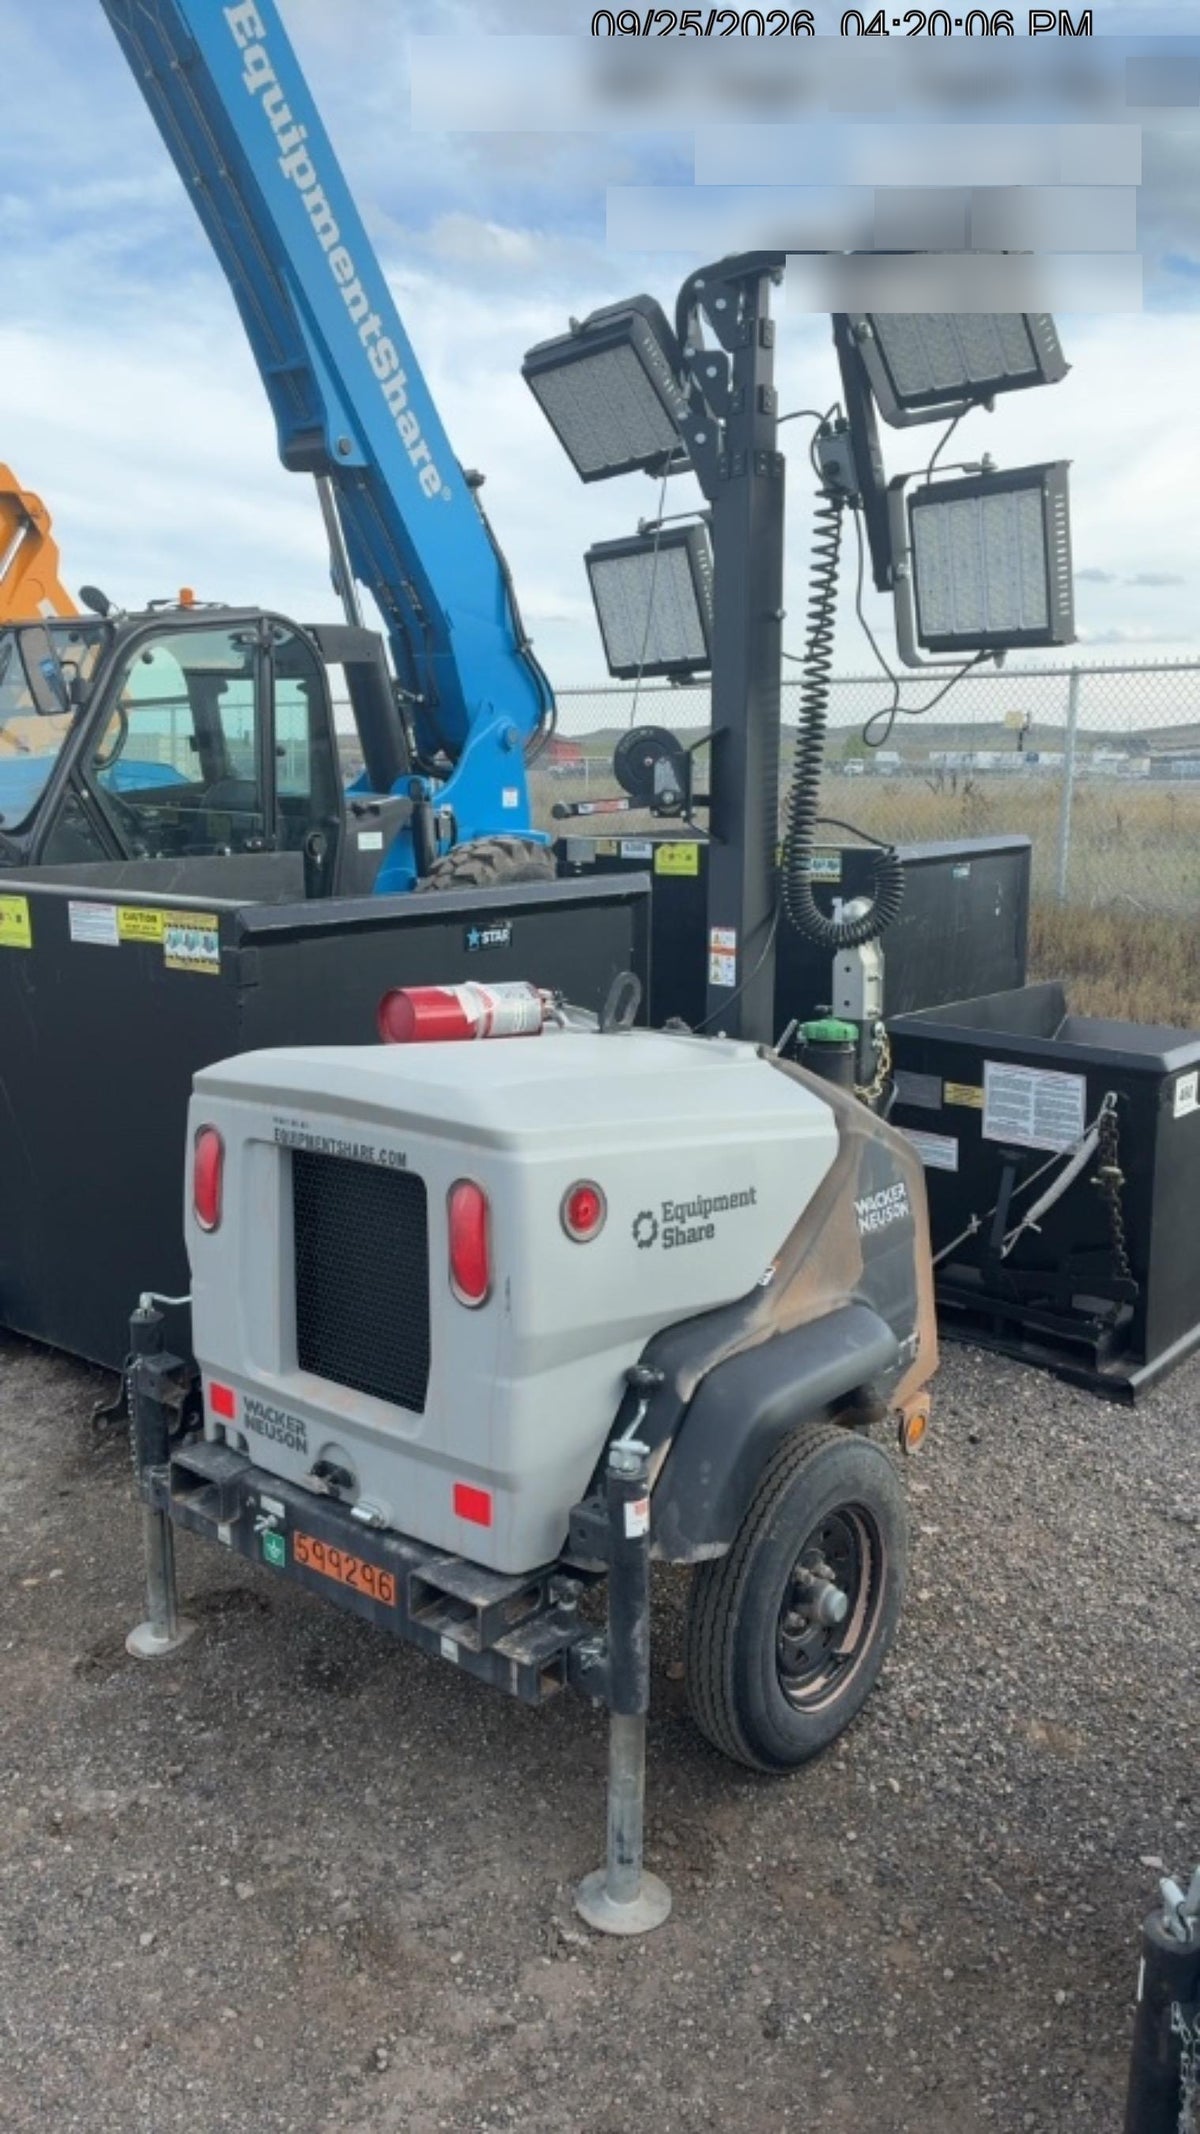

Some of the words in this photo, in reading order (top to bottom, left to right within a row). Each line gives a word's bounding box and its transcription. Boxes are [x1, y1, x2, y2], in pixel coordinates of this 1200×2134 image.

[661, 1186, 757, 1223] Equipment
[854, 1182, 907, 1216] WACKER
[662, 1223, 714, 1249] Share
[858, 1202, 910, 1235] NEUSON
[243, 1396, 306, 1438] WACKER
[244, 1412, 308, 1456] NEUSON
[294, 1535, 393, 1603] 599296
